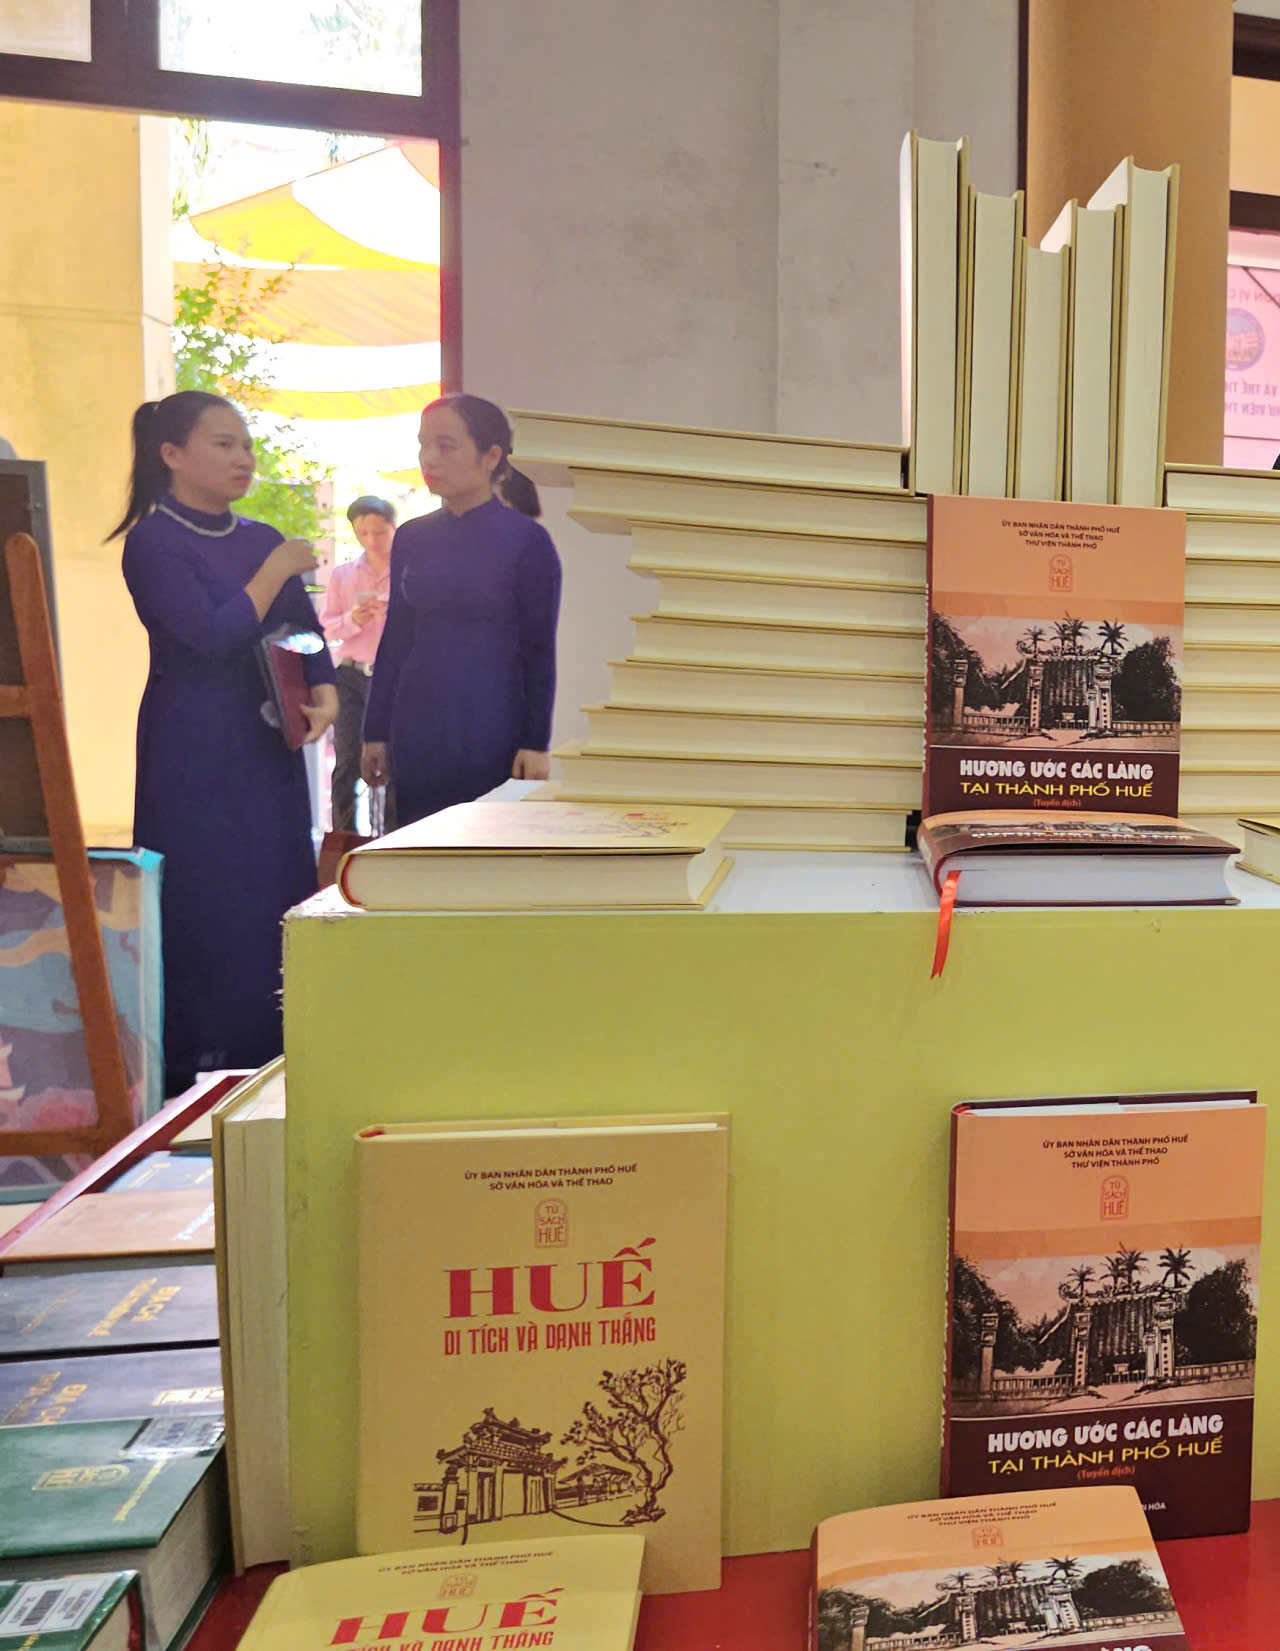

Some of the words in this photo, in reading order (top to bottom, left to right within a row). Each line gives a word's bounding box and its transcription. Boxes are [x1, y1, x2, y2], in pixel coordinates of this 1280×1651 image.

[960, 760, 1026, 777] HƯƠNG
[1031, 759, 1067, 778] ƯỚC
[1071, 760, 1103, 779] CÁC
[1107, 761, 1154, 780] LÀNG
[960, 782, 989, 796] TẠI
[996, 781, 1063, 795] THÀNH
[1069, 781, 1110, 796] PHỐ
[1116, 782, 1153, 797] HUẾ
[1043, 1139, 1055, 1149] ỦY
[1076, 1139, 1100, 1147] NHÂN
[1103, 1138, 1120, 1146] DÂN
[1122, 1136, 1150, 1146] THÀNH
[1152, 1135, 1170, 1144] PHỐ
[1171, 1134, 1189, 1143] HUẾ
[1064, 1150, 1075, 1158] SỞ
[1096, 1149, 1114, 1157] HÓA
[1116, 1148, 1127, 1156] VÀ
[1128, 1147, 1144, 1156] THỂ
[1092, 1160, 1110, 1168] VIỆN
[1112, 1158, 1140, 1167] THÀNH
[1142, 1156, 1160, 1165] PHỐ
[465, 1169, 477, 1180] ỦY
[481, 1171, 501, 1179] BAN
[504, 1169, 532, 1178] NHÂN
[535, 1167, 556, 1177] DÂN
[559, 1167, 592, 1176] THÀNH
[594, 1164, 615, 1174] PHỐ
[618, 1163, 638, 1173] HUẾ
[490, 1181, 503, 1190] SỞ
[505, 1181, 525, 1190] VĂN
[528, 1179, 549, 1189] HÓA
[551, 1179, 563, 1188] VÀ
[566, 1177, 585, 1187] THỂ
[587, 1177, 613, 1186] THAO
[443, 1237, 656, 1318] HUẾ
[444, 1330, 461, 1356] DI
[468, 1323, 509, 1355] TÍCH
[516, 1321, 538, 1353] VÀ
[546, 1322, 591, 1352] DANH
[598, 1312, 656, 1346] THẮNG
[987, 1427, 1068, 1453] HƯƠNG
[1074, 1420, 1118, 1445] ƯỚC
[1123, 1416, 1162, 1441] CÁC
[1168, 1413, 1224, 1437] LÀNG
[988, 1458, 1024, 1475] TẠI
[1031, 1449, 1114, 1471] THÀNH
[1121, 1439, 1170, 1462] PHỐ
[1177, 1435, 1223, 1457] HUẾ
[1077, 1468, 1109, 1481] (Tuyển
[1111, 1465, 1136, 1478] dịch)
[1148, 1501, 1166, 1511] HÓA
[329, 1587, 565, 1645] HUẾ
[431, 1637, 483, 1651] DANH
[491, 1631, 554, 1650] THẮNG
